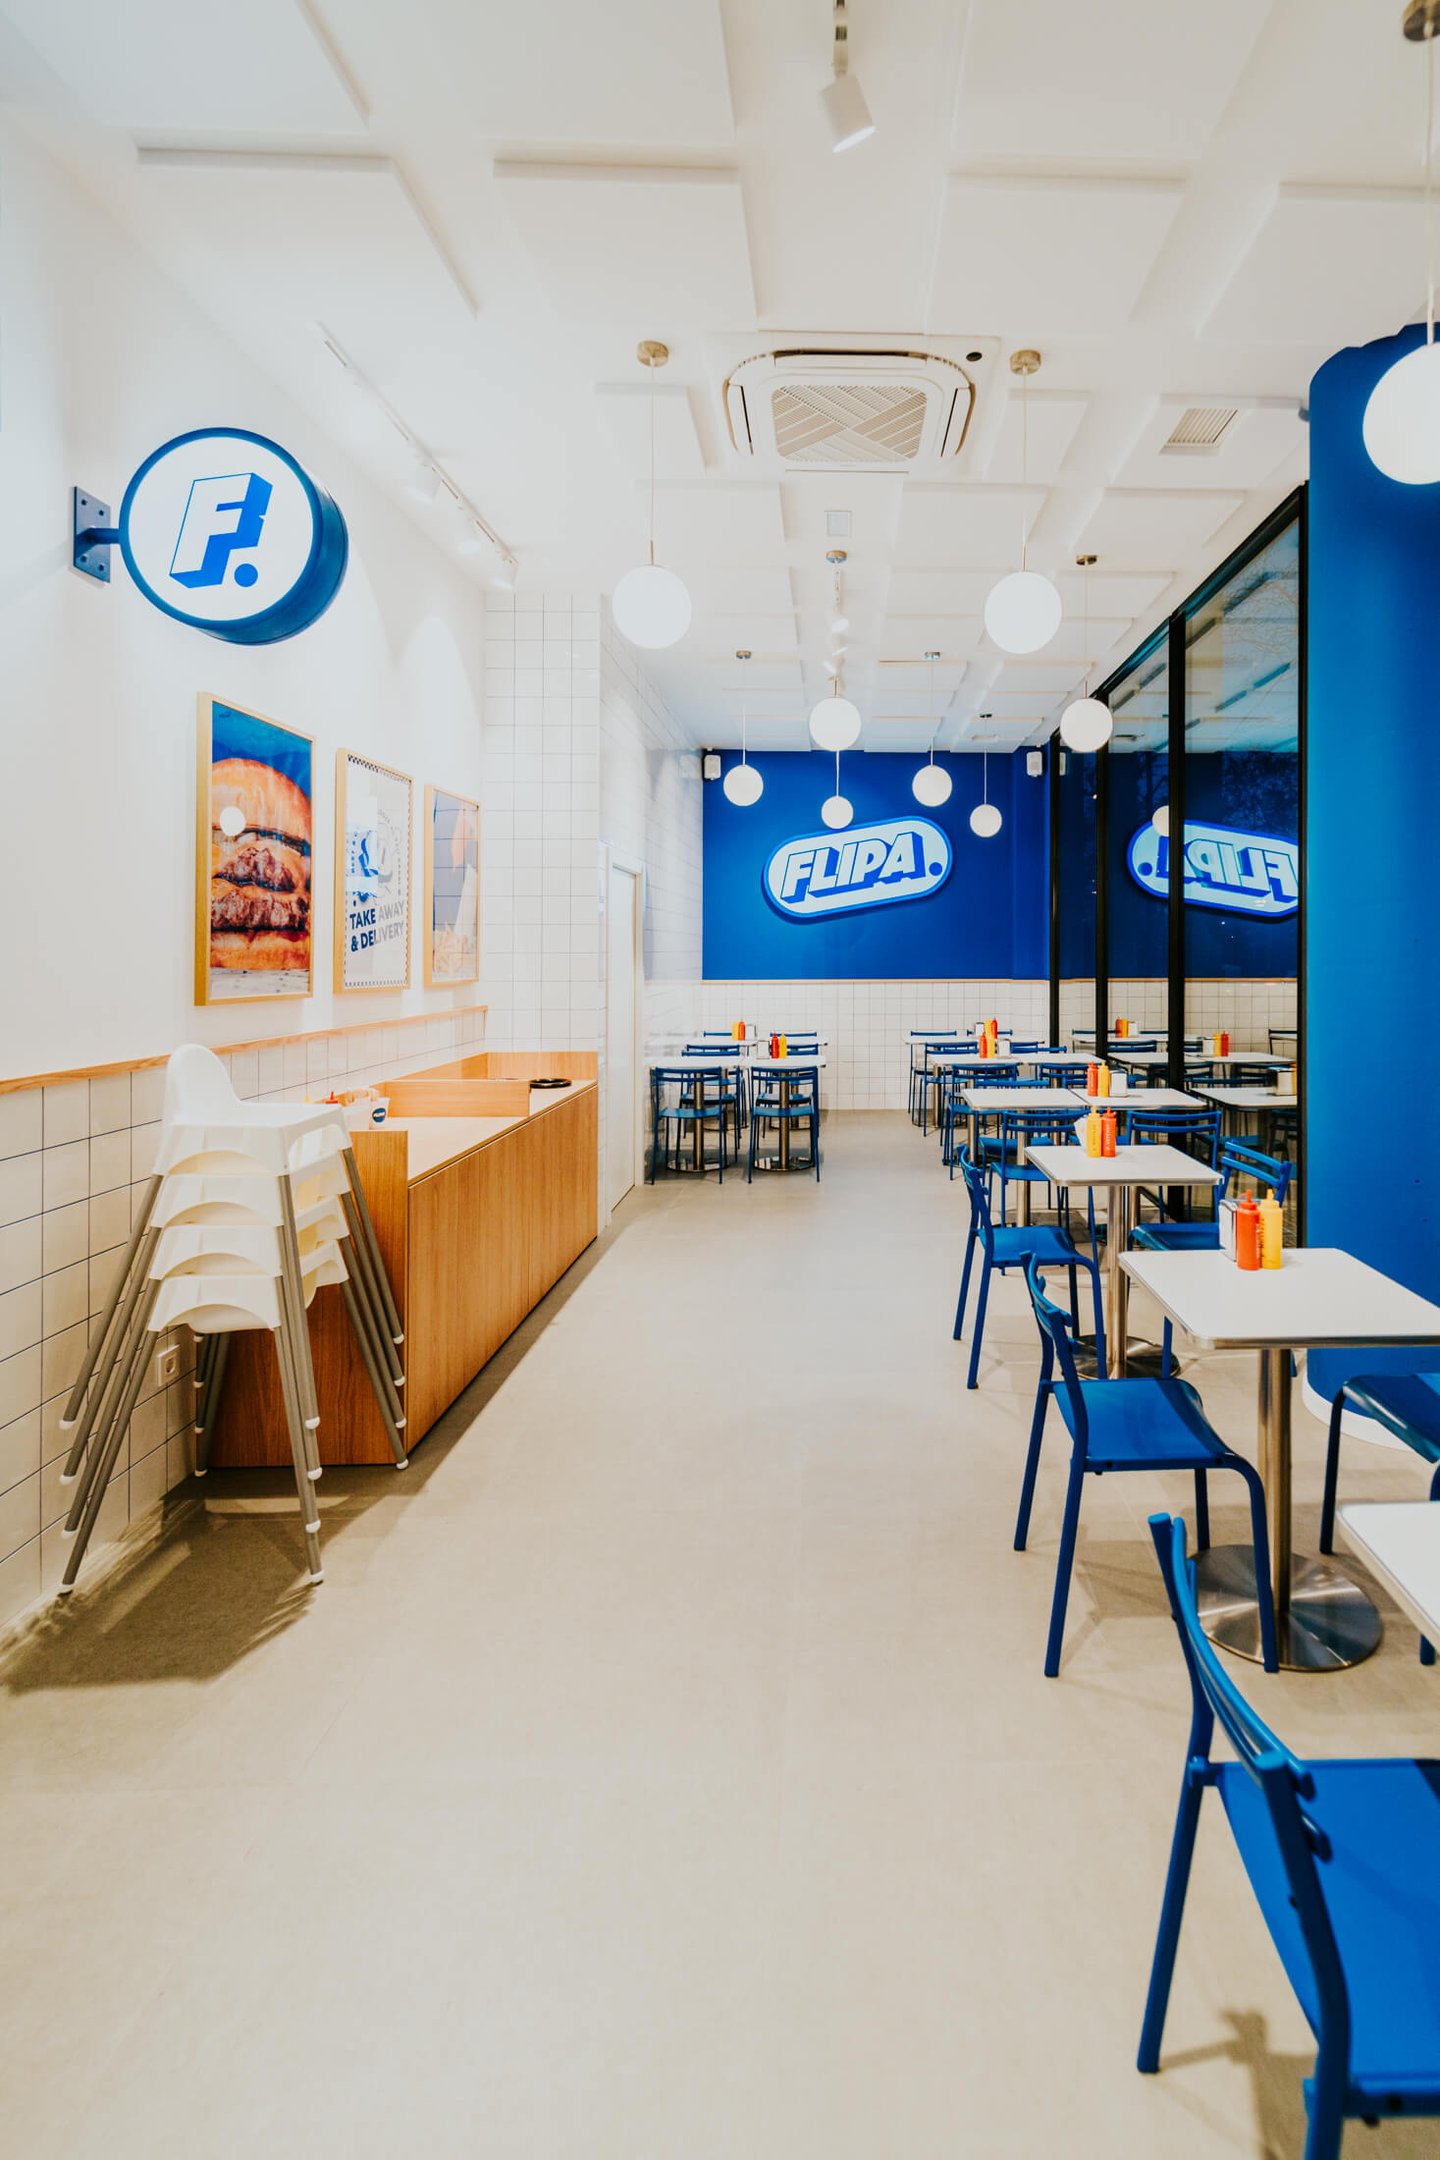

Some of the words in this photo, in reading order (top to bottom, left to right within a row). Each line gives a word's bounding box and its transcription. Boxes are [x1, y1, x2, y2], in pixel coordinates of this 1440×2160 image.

[349, 908, 377, 931] TAKE
[379, 900, 405, 921] AWAY
[350, 935, 359, 952] &
[360, 920, 405, 950] DELIVERY
